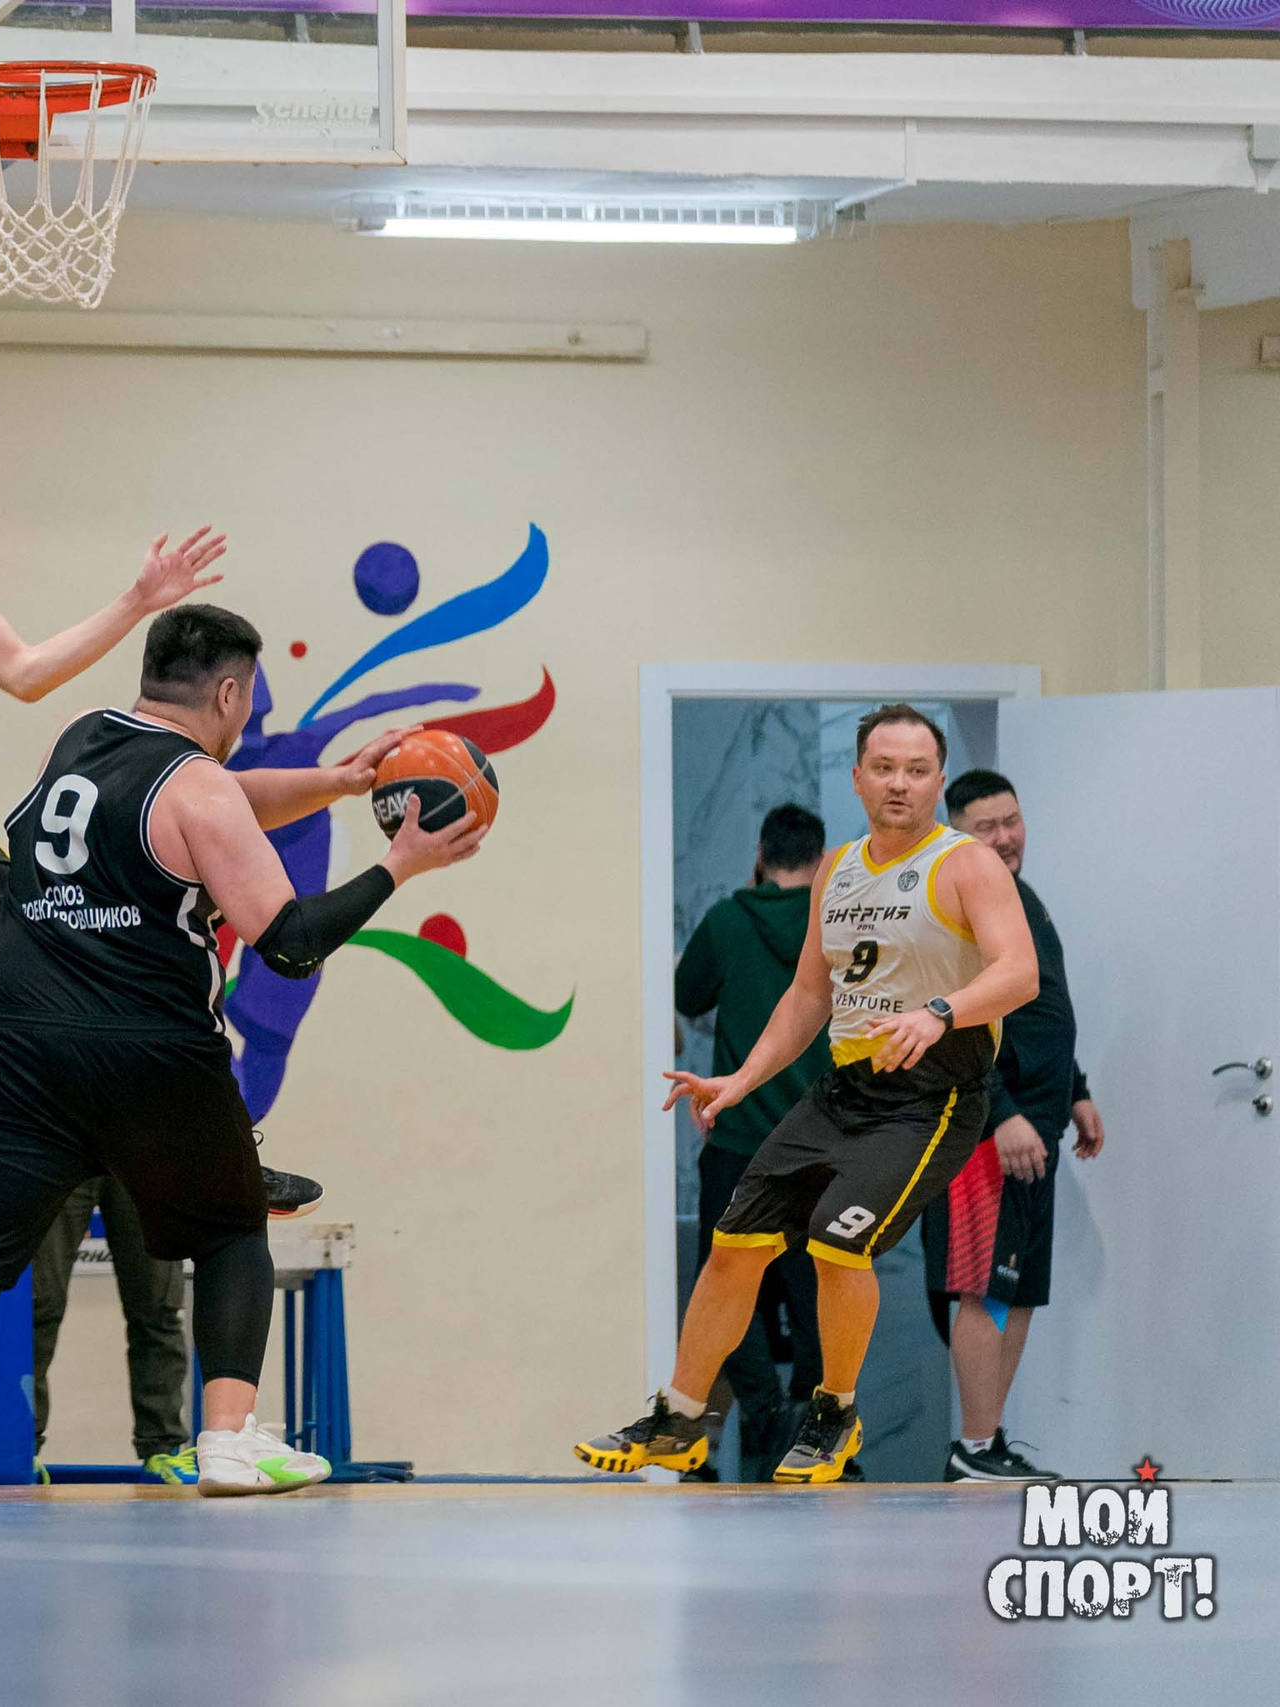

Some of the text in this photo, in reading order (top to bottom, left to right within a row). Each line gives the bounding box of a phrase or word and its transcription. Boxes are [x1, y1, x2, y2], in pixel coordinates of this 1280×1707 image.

[35, 773, 99, 875] 9
[45, 885, 85, 907] СОЮЗ
[843, 940, 880, 984] 9
[835, 993, 904, 1014] VENTURE
[825, 1205, 876, 1239] 9
